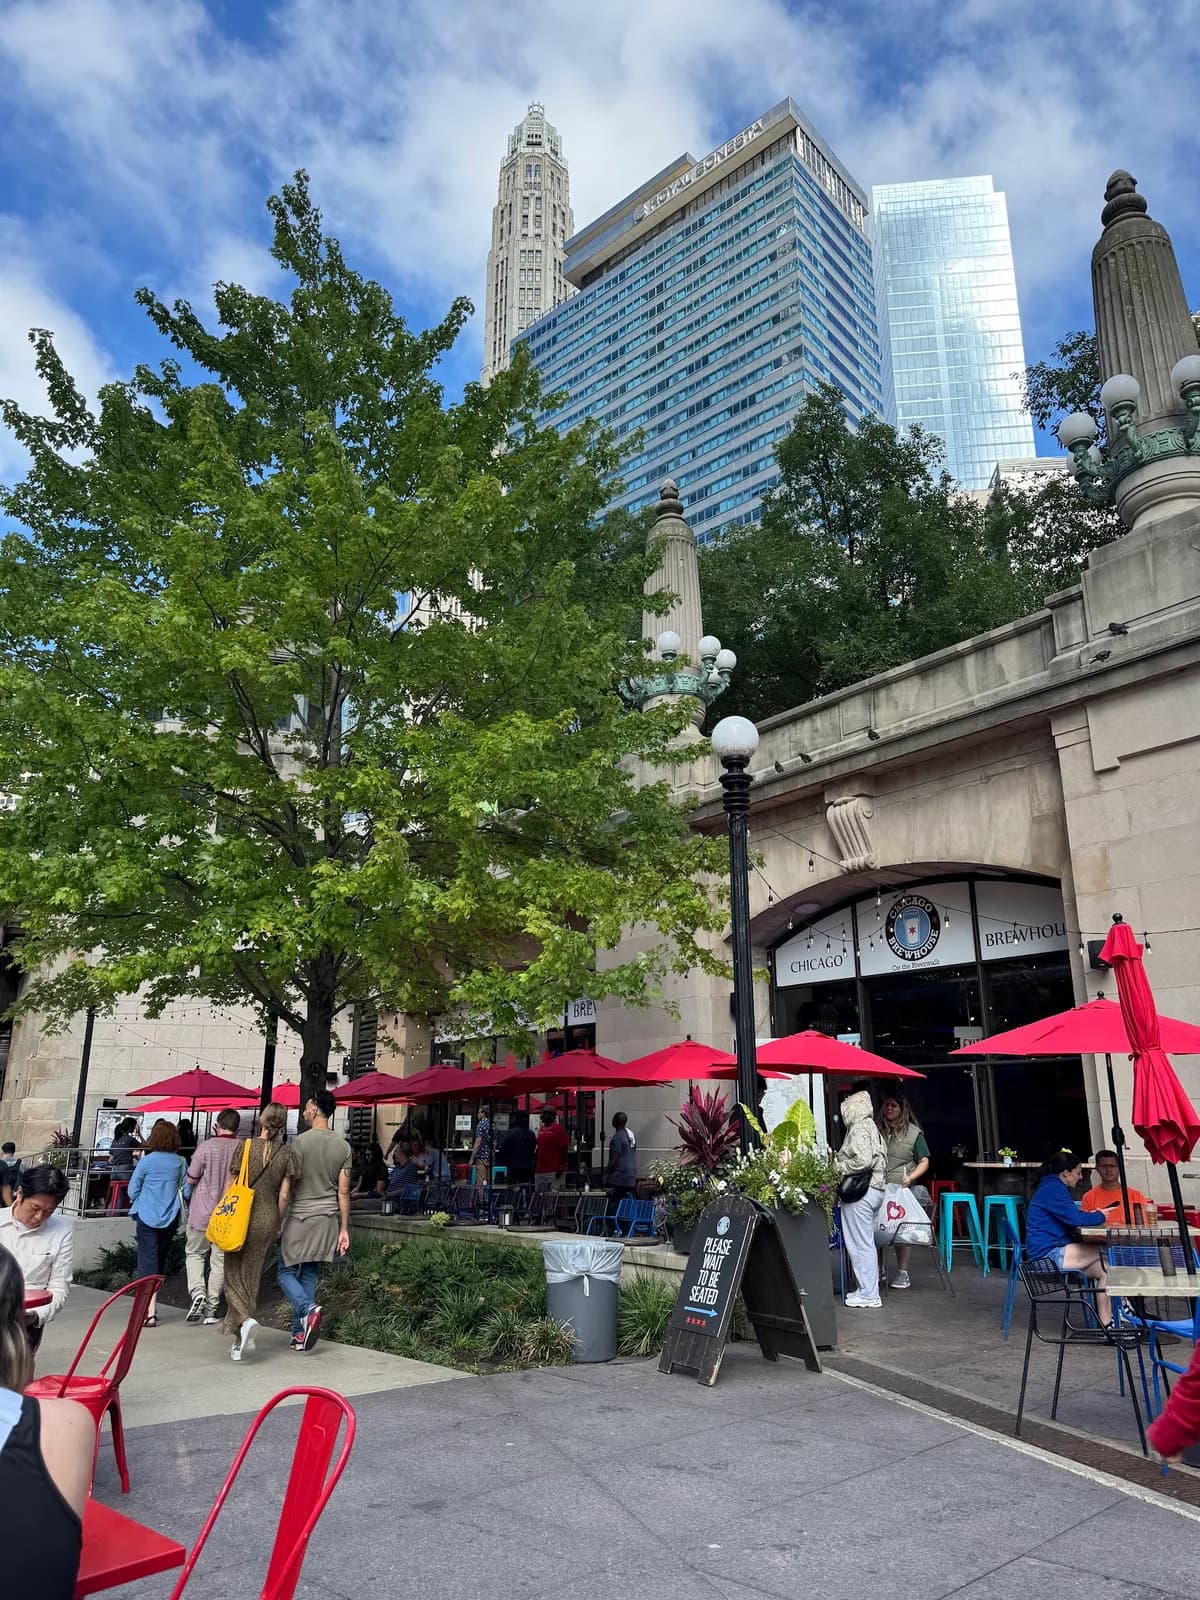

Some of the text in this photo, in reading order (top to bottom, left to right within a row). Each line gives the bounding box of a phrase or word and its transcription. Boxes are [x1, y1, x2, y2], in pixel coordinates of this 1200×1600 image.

[649, 118, 764, 211] ROYAL SONESTA
[889, 896, 933, 919] CHICAGO
[888, 928, 939, 960] BREWHOUSE
[790, 954, 843, 973] CHICAGO
[573, 1000, 597, 1018] BRE
[963, 1038, 981, 1048] EX
[703, 1237, 733, 1255] PLEASE
[702, 1253, 725, 1271] WAIT
[697, 1269, 720, 1288] TO BE
[689, 1285, 719, 1305] SEATED
